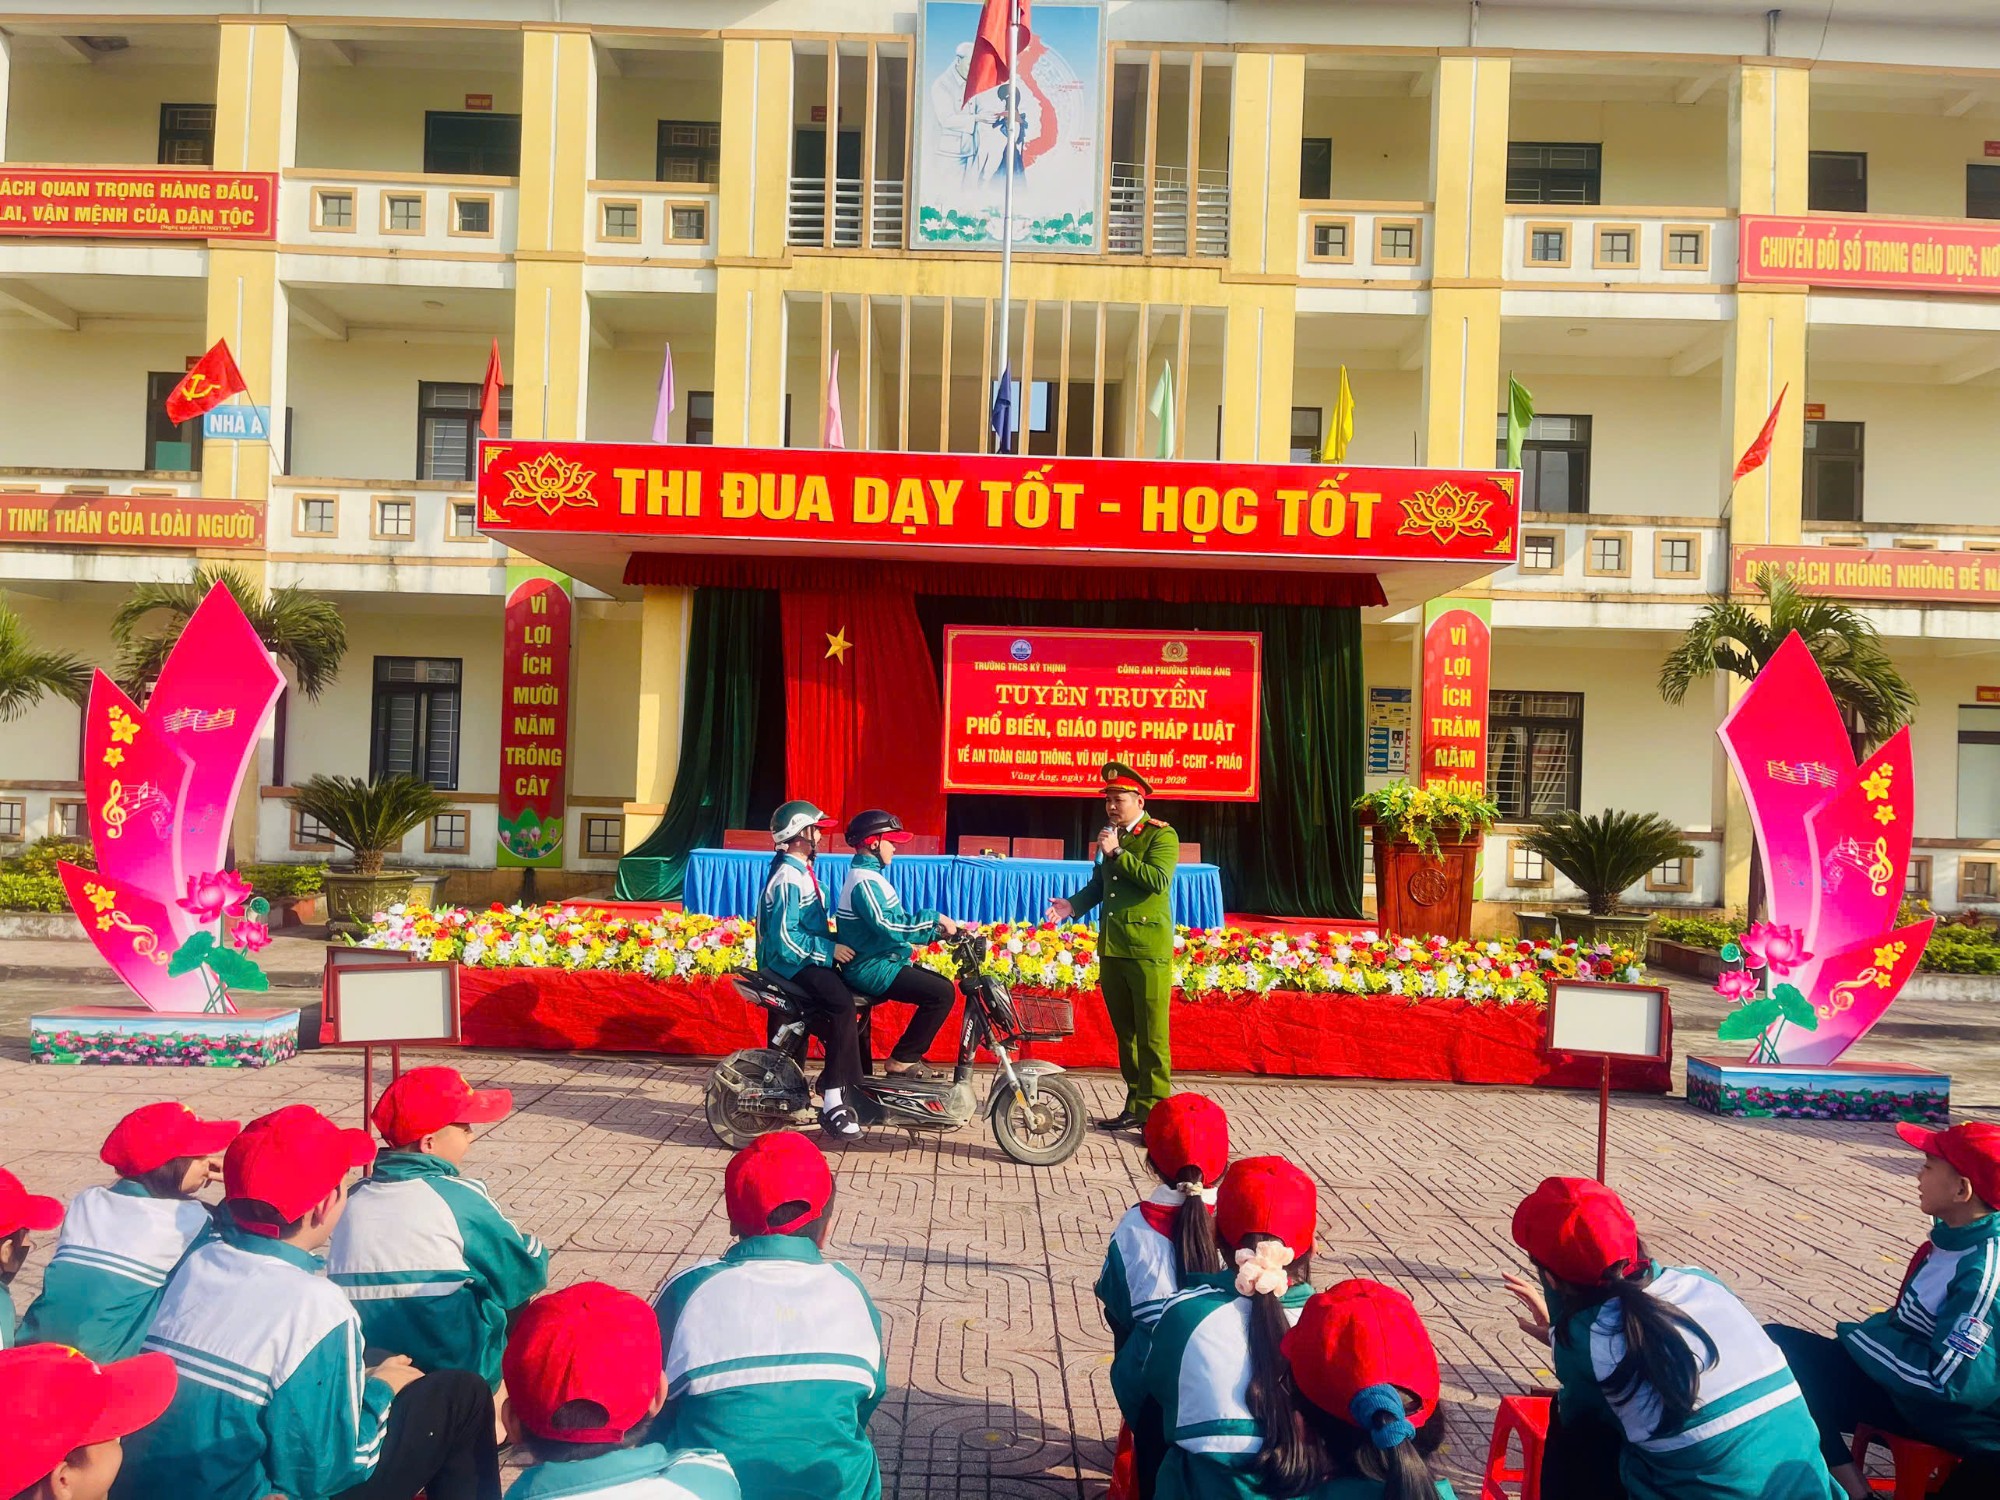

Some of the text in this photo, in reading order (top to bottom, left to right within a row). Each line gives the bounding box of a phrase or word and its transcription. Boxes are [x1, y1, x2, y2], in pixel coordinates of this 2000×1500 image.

[42, 181, 89, 198] QUAN
[96, 181, 154, 201] TRỌNG
[160, 180, 210, 199] HÀNG
[216, 180, 259, 202] ĐẦU,
[0, 203, 254, 228] AI, VẬN MỆNH CỦA DÂN TỘC
[1760, 225, 1813, 269] CHUYỂN
[1816, 227, 1839, 271] ĐỔI
[1843, 229, 1862, 272] SỐ
[1865, 240, 1908, 274] TRONG
[1912, 237, 1943, 275] GIÁO
[1947, 244, 1977, 283] DỤC:
[210, 413, 263, 434] NHÀ A
[613, 465, 1381, 543] THI ĐUA DẠY TỐT - HỌC TỐT
[8, 508, 48, 532] TINH
[55, 503, 102, 534] THẦN
[108, 502, 144, 536] CỦA
[151, 508, 191, 537] LOÀI
[197, 509, 255, 539] NGƯỜI
[1786, 557, 1830, 585] SÁCH
[1835, 558, 1892, 588] KHÔNG
[1897, 560, 1954, 590] NHỮNG
[1958, 558, 1981, 590] ĐỂ
[530, 595, 547, 614] VÌ
[524, 625, 551, 648] LỢI
[1451, 624, 1466, 646] VÌ
[522, 653, 552, 675] ÍCH
[974, 660, 1066, 674] TRƯỜNG THCS KỲ THỊNH
[1117, 664, 1231, 676] CÔNG AN PHƯỜNG VŨNG ÁNG
[1444, 657, 1471, 680] LỢI
[513, 685, 559, 706] MƯỜI
[995, 678, 1207, 709] TUYÊN TRUYỀN
[1442, 687, 1471, 708] ÍCH
[514, 714, 555, 736] NĂM
[966, 711, 1235, 745] PHỔ BIẾN, GIÁO DỤC PHÁP LUẬT
[1431, 715, 1480, 738] TRĂM
[505, 741, 563, 767] TRỒNG
[957, 744, 970, 763] VỀ
[972, 748, 986, 763] AN
[988, 746, 1013, 764] TOÀN
[1015, 749, 1037, 765] GIAO
[1040, 748, 1074, 766] THÔNG,
[1076, 749, 1089, 766] VŨ
[1091, 749, 1108, 766] KHÍ
[1137, 750, 1158, 770] LIỆU
[1160, 748, 1175, 768] NỔ
[1182, 754, 1207, 769] CCHT
[1216, 752, 1242, 770] PHÁO
[1435, 745, 1476, 768] NĂM
[515, 774, 550, 796] CÂY
[1010, 771, 1036, 781] Vũng
[1061, 774, 1084, 783] ngày
[1087, 773, 1097, 782] 14
[1165, 775, 1187, 784] 2026
